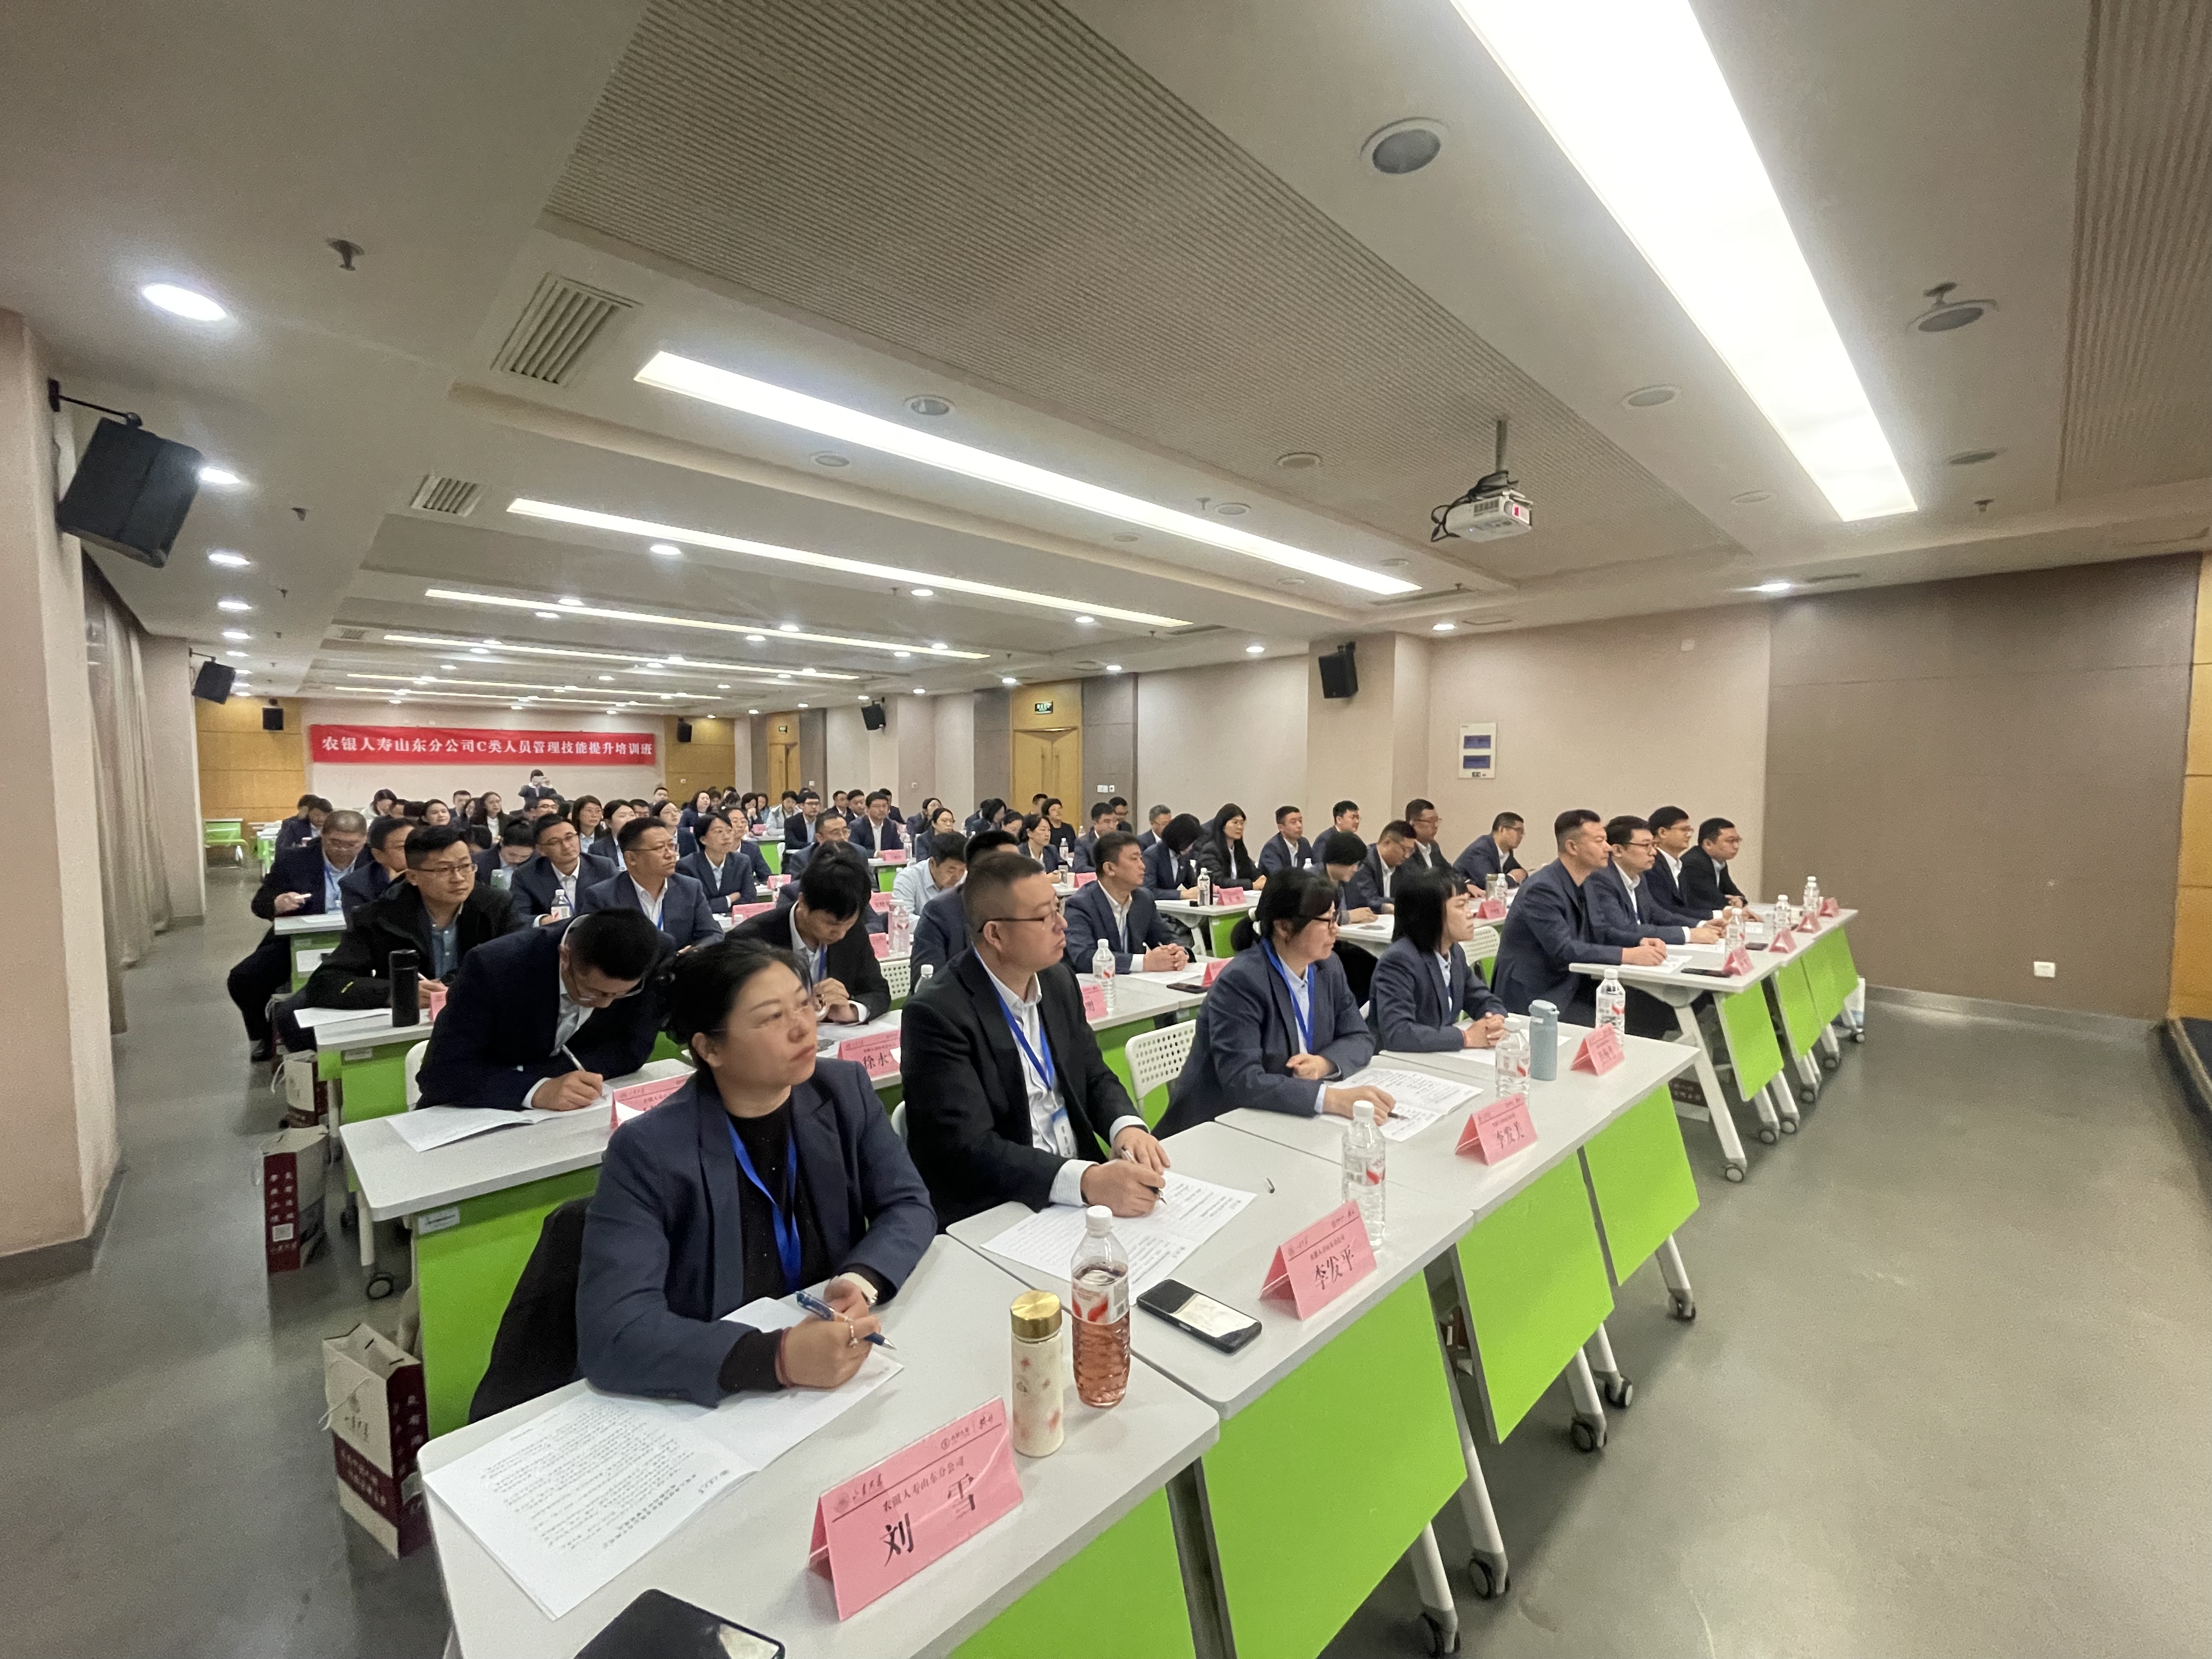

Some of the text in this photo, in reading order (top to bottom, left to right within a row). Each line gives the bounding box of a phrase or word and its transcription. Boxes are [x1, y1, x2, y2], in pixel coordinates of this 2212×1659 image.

[322, 736, 653, 755] 农银人寿山东分公司C类人员管理技能提升培训班
[1314, 1244, 1355, 1290] 李发平
[879, 1473, 976, 1567] 刘雪
